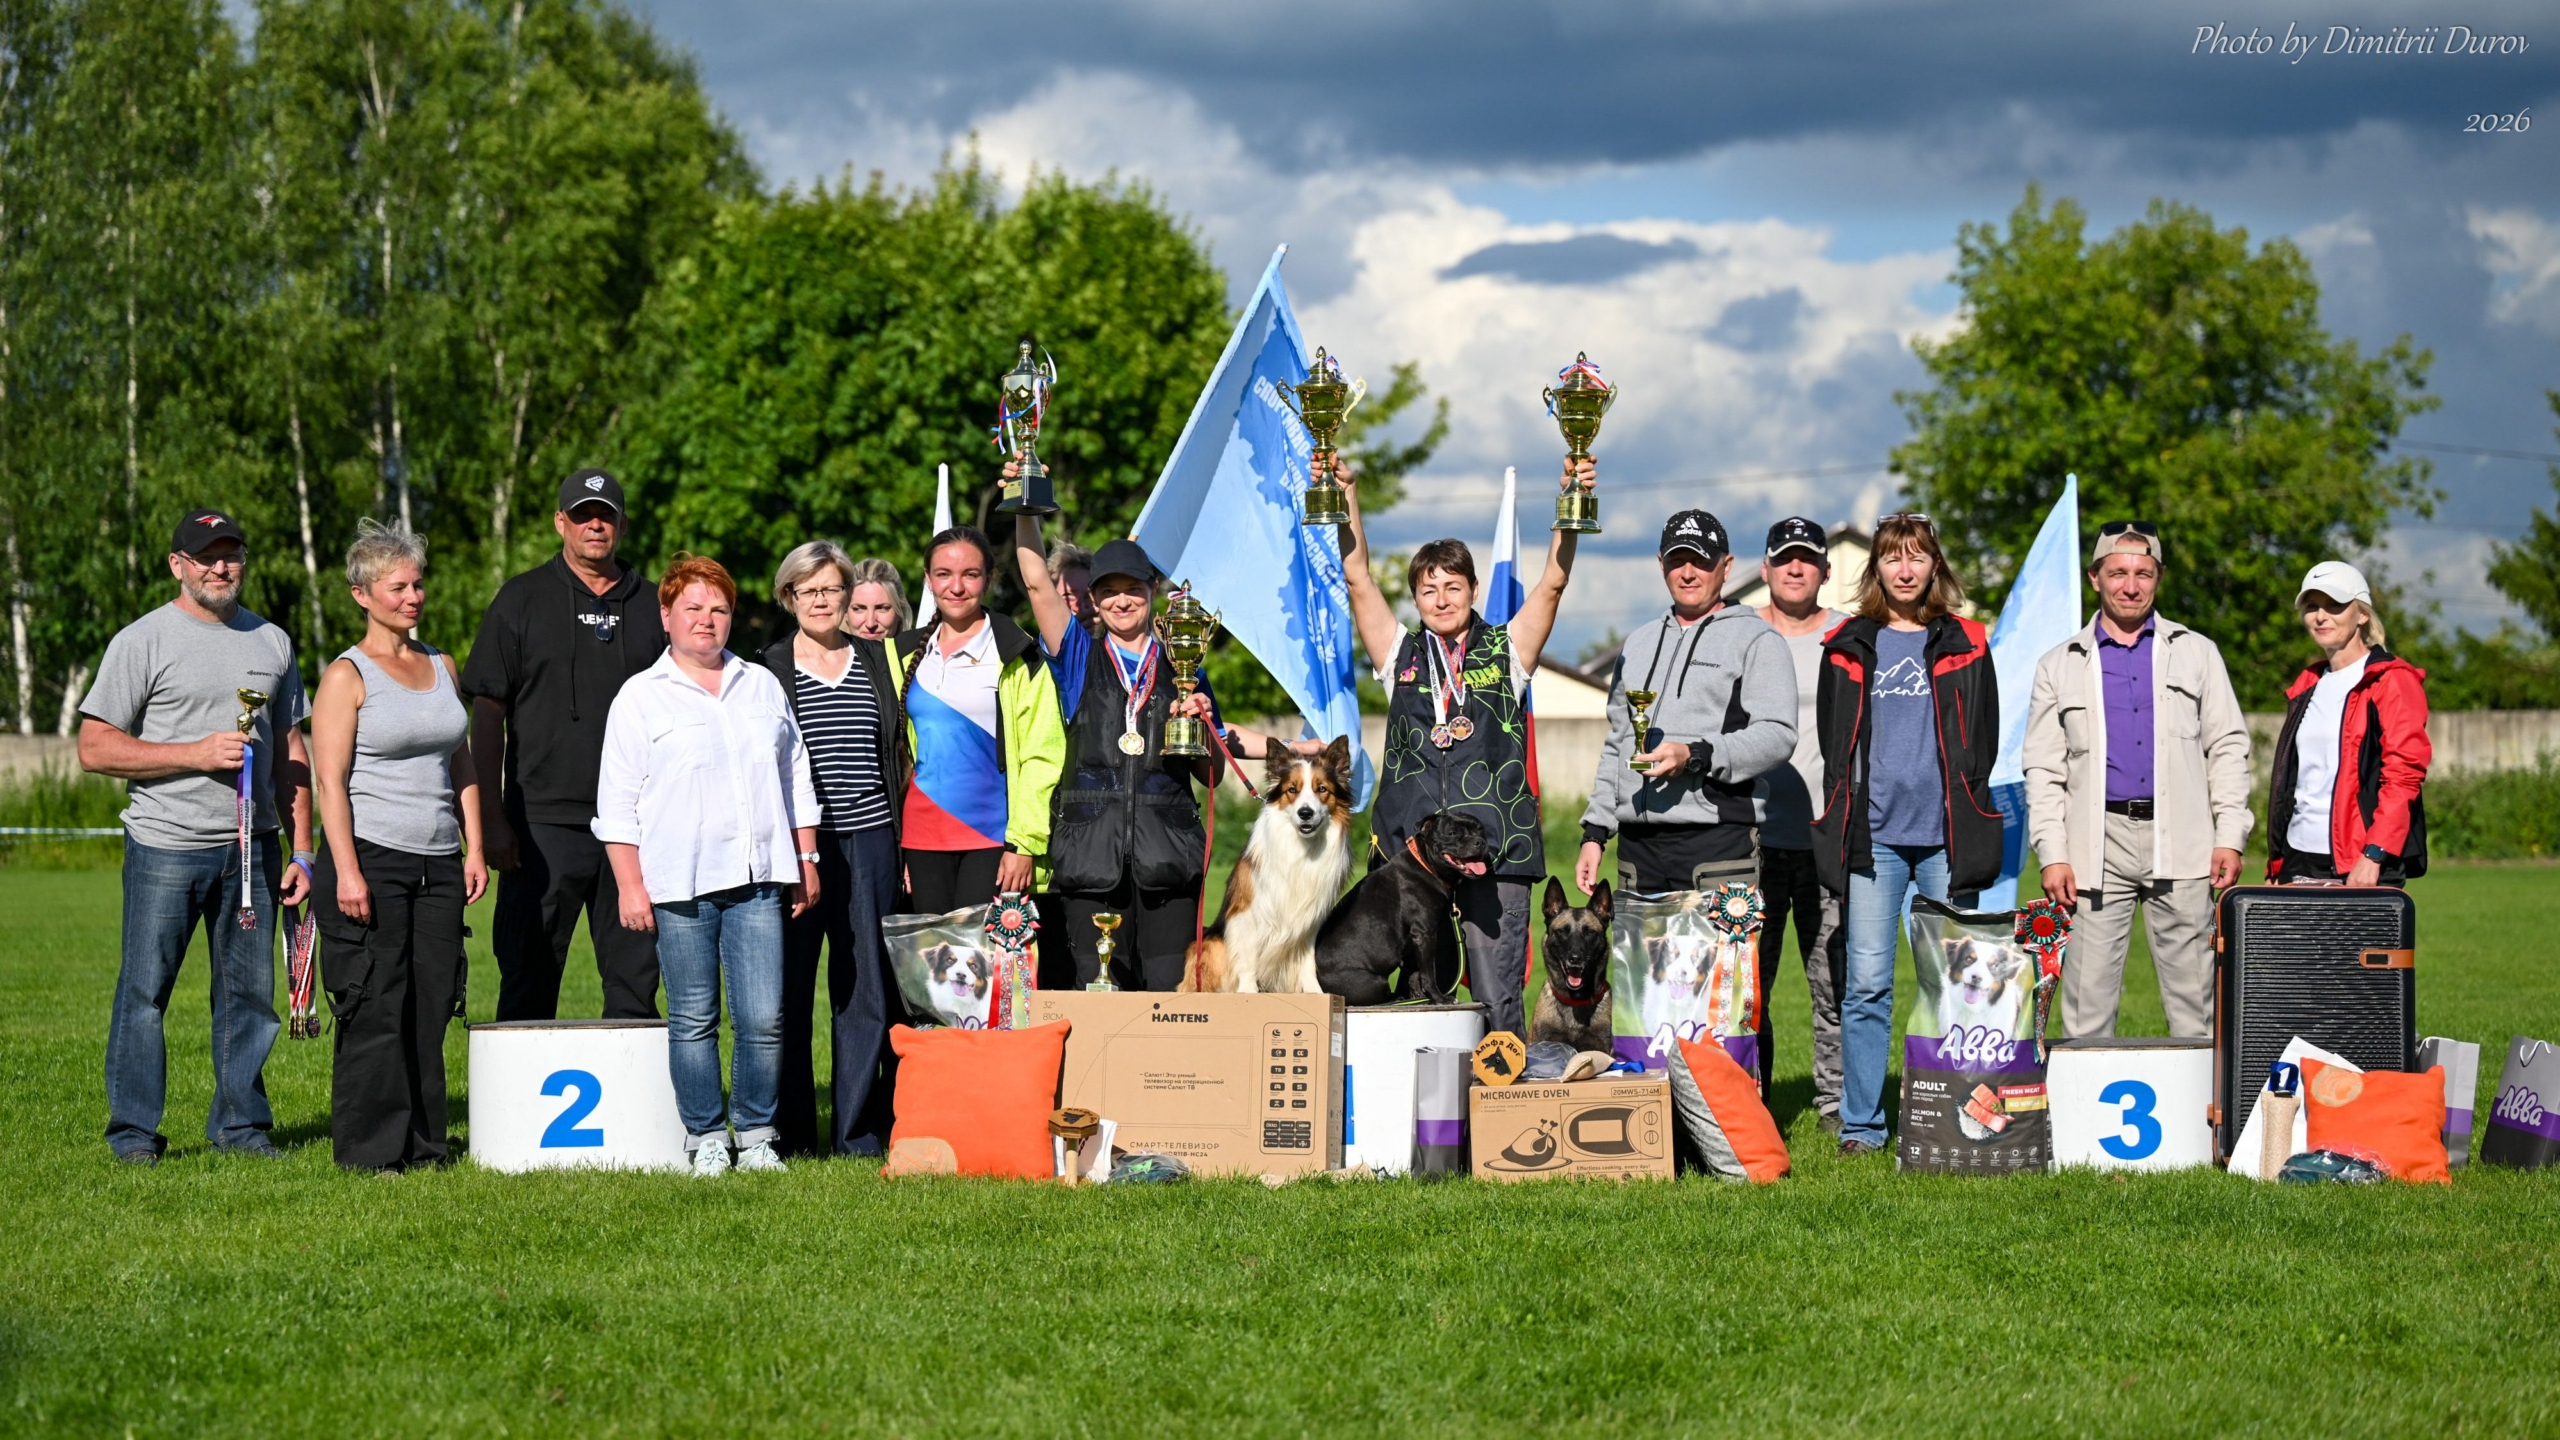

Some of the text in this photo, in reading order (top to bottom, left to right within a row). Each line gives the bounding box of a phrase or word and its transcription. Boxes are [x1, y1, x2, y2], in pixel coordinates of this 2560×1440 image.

[1675, 528, 1703, 537] adidas
[1152, 1013, 1209, 1023] HARTENS
[1475, 1039, 1521, 1056] Альфа Дог
[1913, 1081, 1947, 1091] ADULT
[1480, 1089, 1570, 1100] MICROWAVE OVEN
[1612, 1087, 1660, 1096] 20MWS-714M
[540, 1069, 604, 1148] 2
[2098, 1080, 2162, 1160] 3
[1129, 1141, 1220, 1150] СМАРТ-ТЕЛЕВИЗОР
[1910, 1147, 1920, 1155] 12
